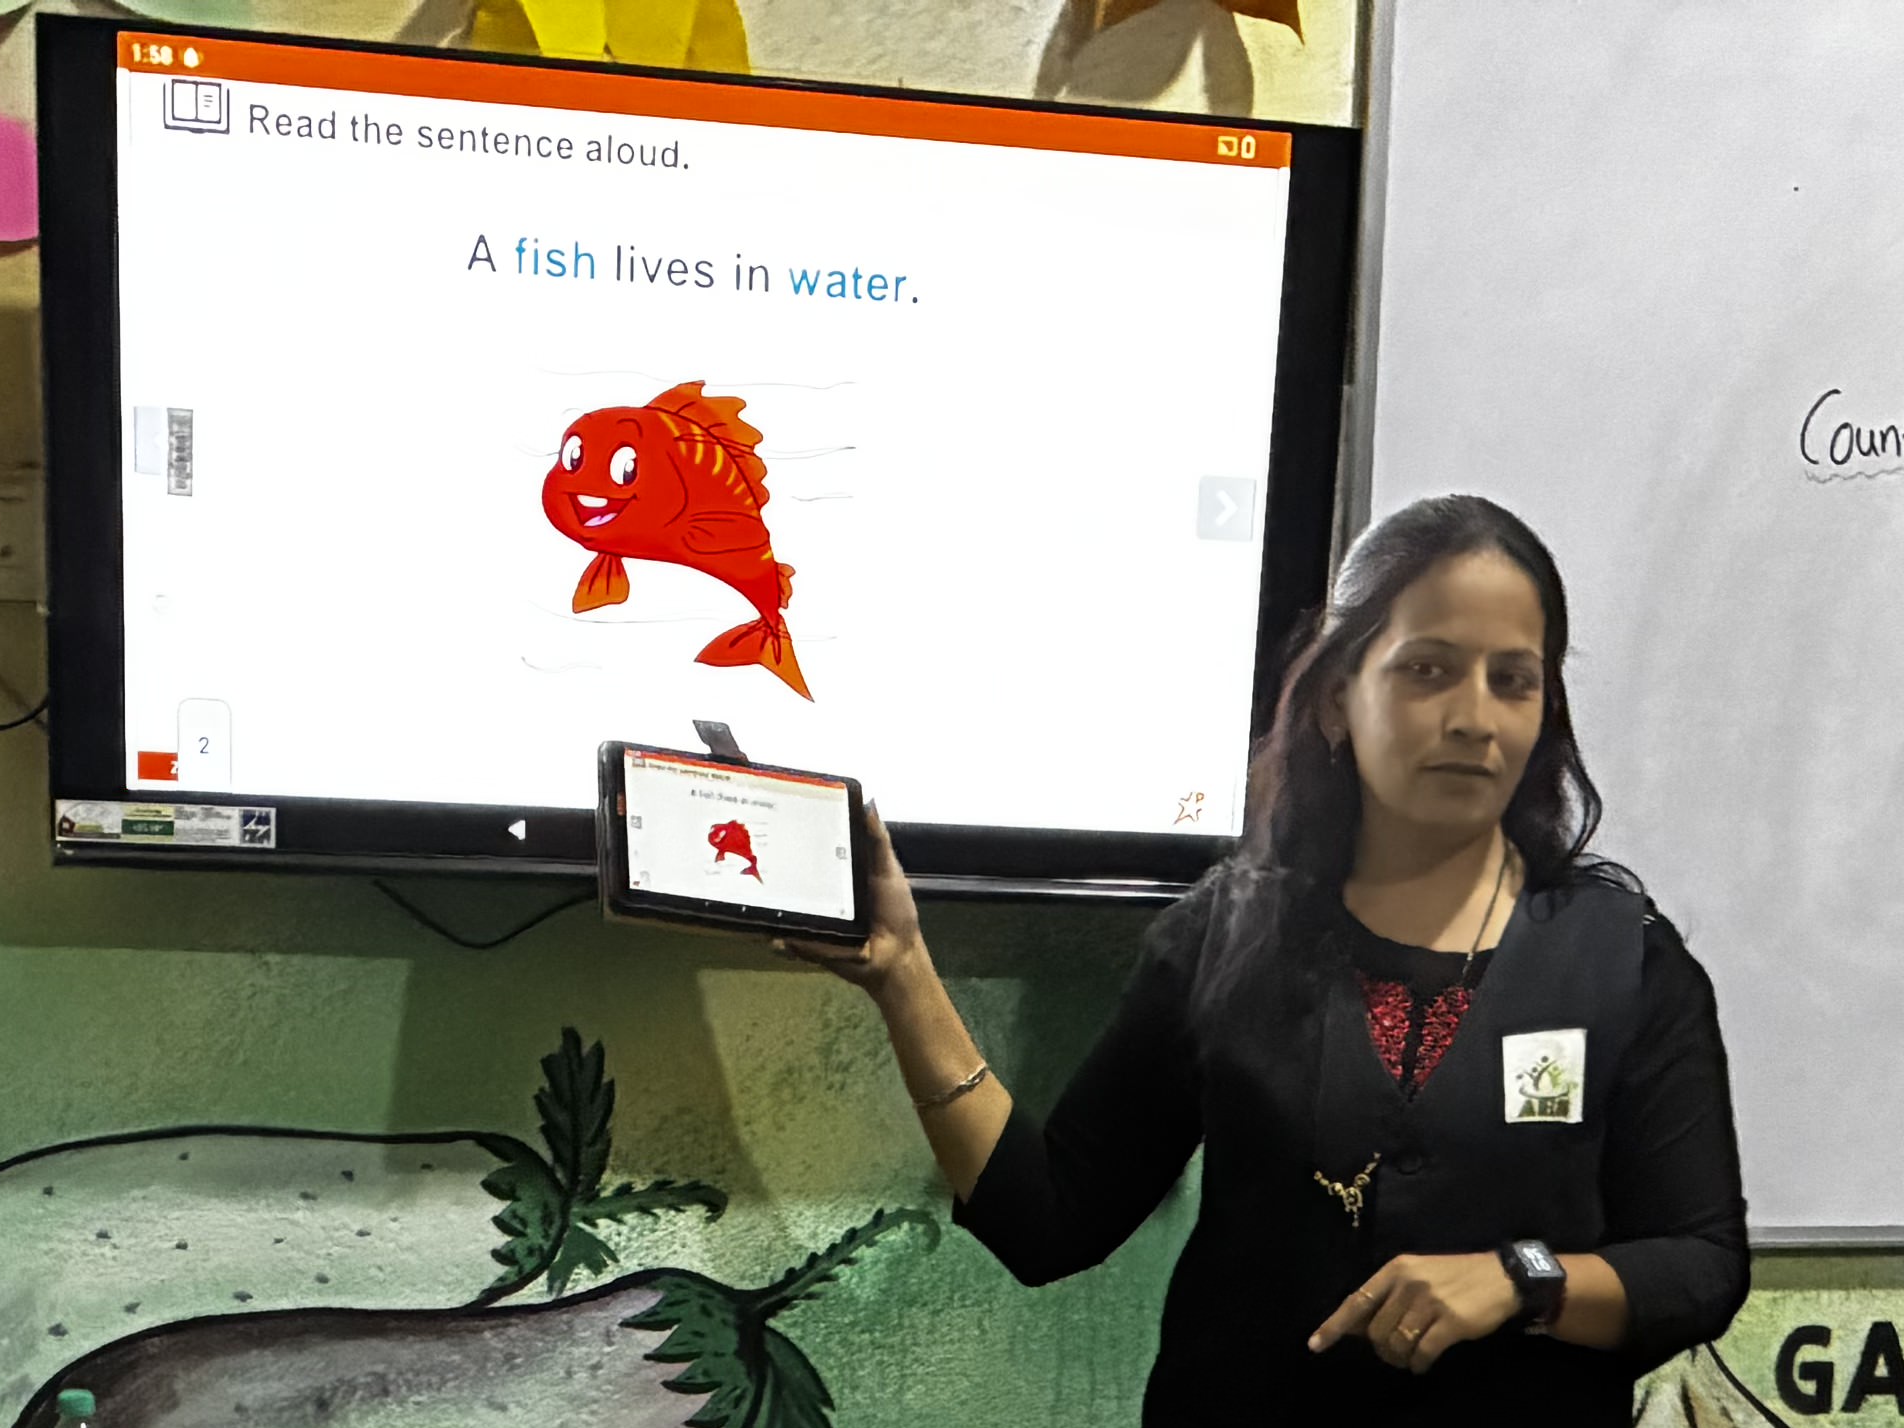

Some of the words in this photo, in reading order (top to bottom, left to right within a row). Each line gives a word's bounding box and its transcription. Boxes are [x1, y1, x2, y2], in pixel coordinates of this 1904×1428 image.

[248, 104, 337, 140] Read
[350, 113, 403, 145] the
[417, 125, 574, 159] sentence
[585, 135, 690, 170] aloud.
[467, 234, 497, 272] A
[515, 237, 595, 279] fish
[615, 245, 715, 288] lives
[735, 253, 769, 292] in
[788, 267, 918, 304] water.
[198, 737, 210, 755] 2
